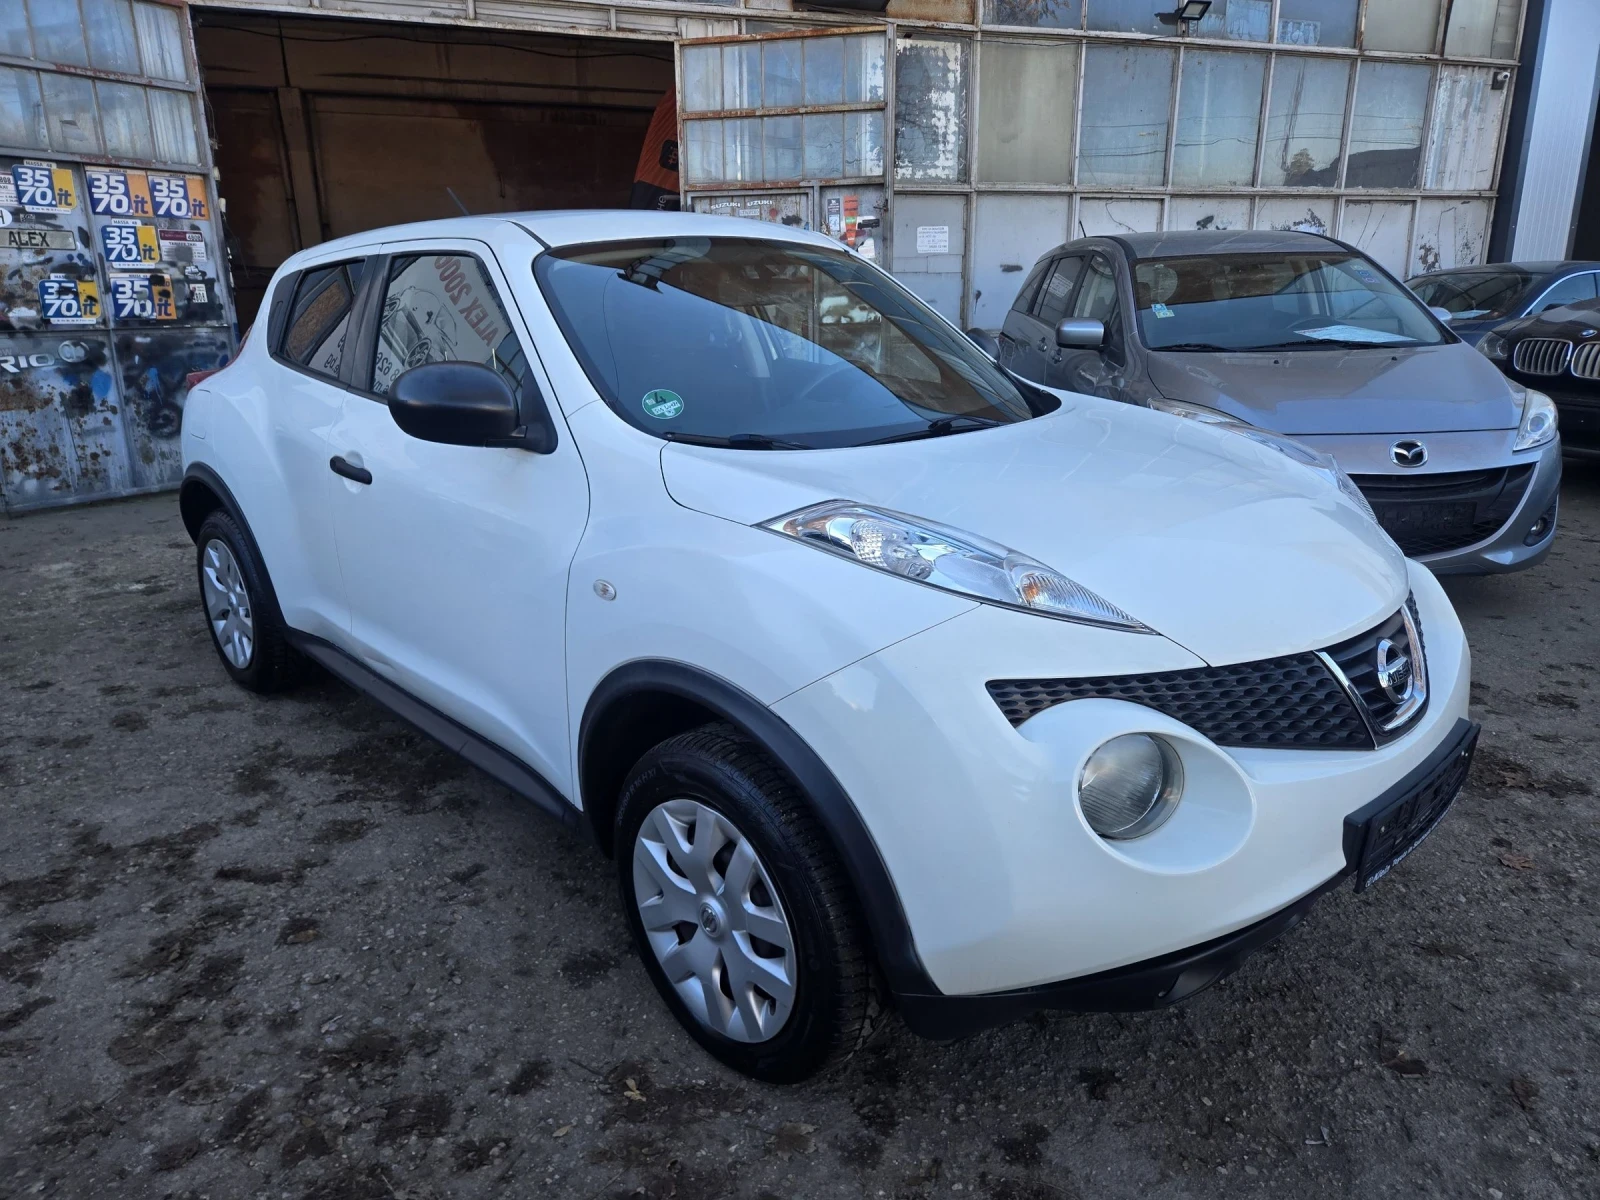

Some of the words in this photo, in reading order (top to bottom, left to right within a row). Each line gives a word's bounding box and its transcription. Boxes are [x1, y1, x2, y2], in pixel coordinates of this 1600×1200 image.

[17, 168, 50, 187] 35
[91, 174, 126, 194] 35
[153, 178, 185, 198] 35
[8, 231, 50, 248] ALEX
[105, 227, 135, 245] 35
[115, 280, 149, 299] 35
[654, 392, 667, 404] 4
